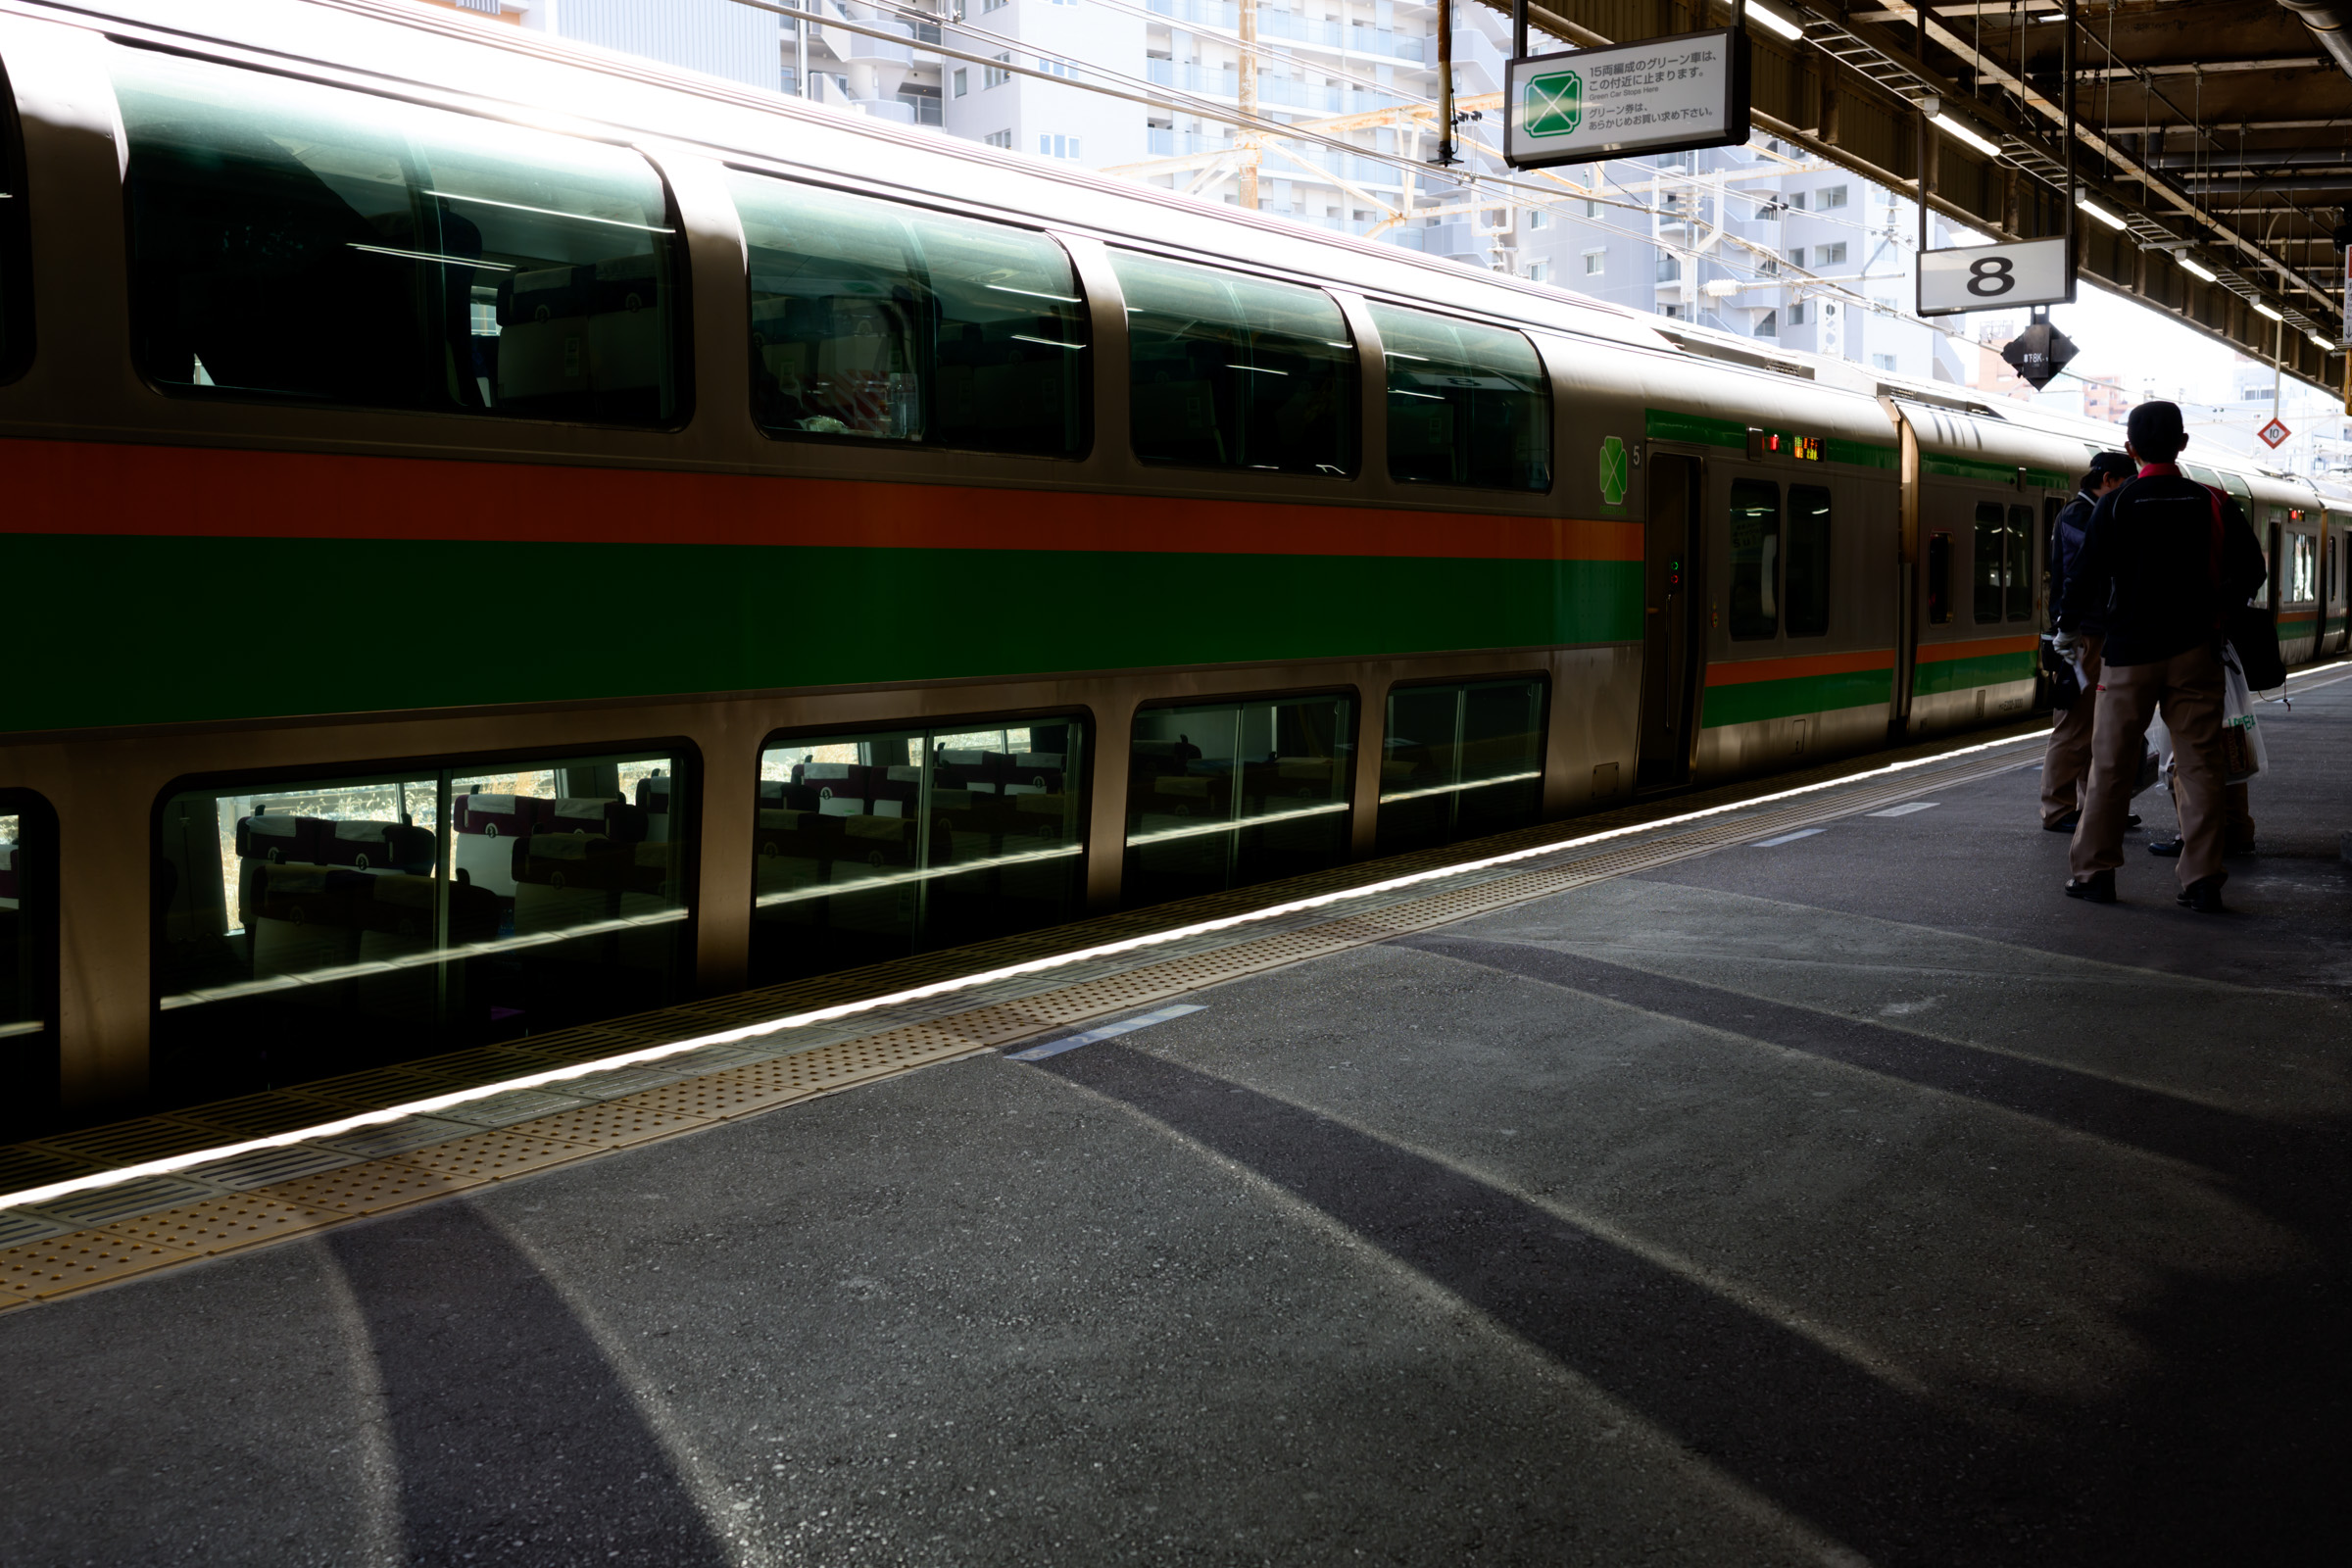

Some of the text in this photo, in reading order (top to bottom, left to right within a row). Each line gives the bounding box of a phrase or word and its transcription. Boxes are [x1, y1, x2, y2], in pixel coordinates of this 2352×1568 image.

[1590, 51, 1717, 77] 15両編成のグリーン車は、
[1589, 67, 1703, 91] この付近に止まります。
[1623, 88, 1642, 97] Stops
[1589, 103, 1647, 119] グリーン券は、
[1589, 107, 1712, 130] あらかじめお買い求め下さい。
[1967, 256, 2016, 297] 8
[2269, 428, 2279, 439] 10
[1633, 445, 1641, 466] 5
